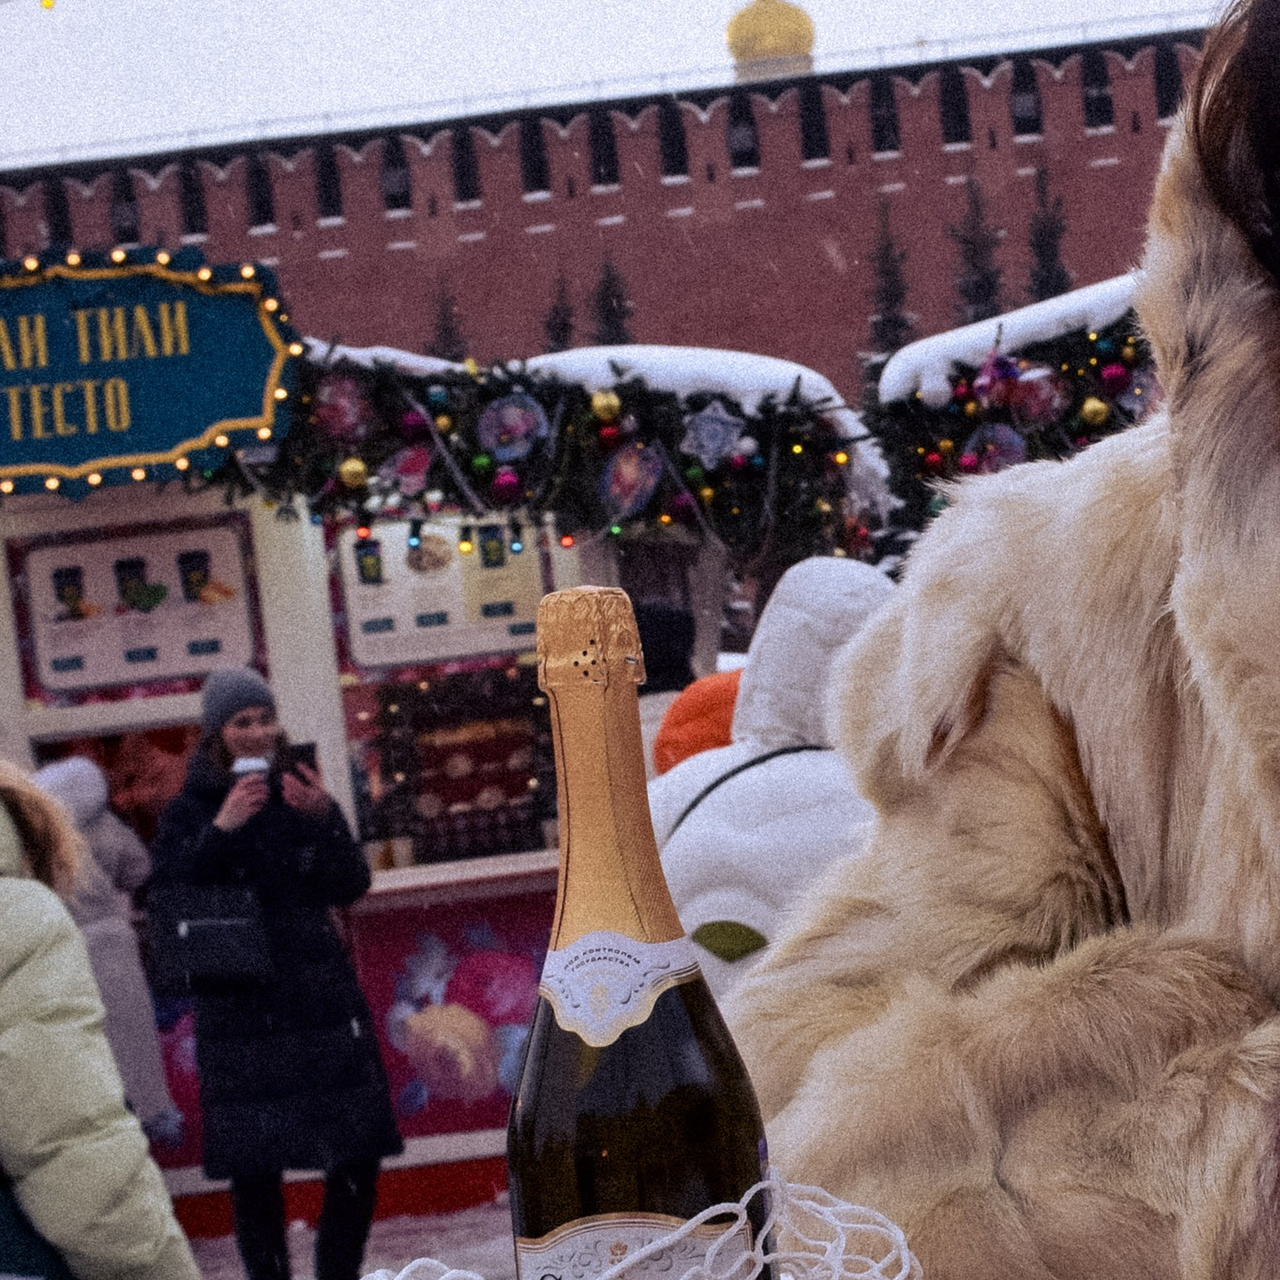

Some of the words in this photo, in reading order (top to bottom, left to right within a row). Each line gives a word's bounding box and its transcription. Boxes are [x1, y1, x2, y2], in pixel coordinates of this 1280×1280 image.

[73, 301, 190, 364] ТИЛИ
[2, 377, 131, 441] ТЕСТО
[571, 956, 630, 972] ГОСУДАРСТВА
[582, 947, 641, 965] КОНТРОЛЕМ
